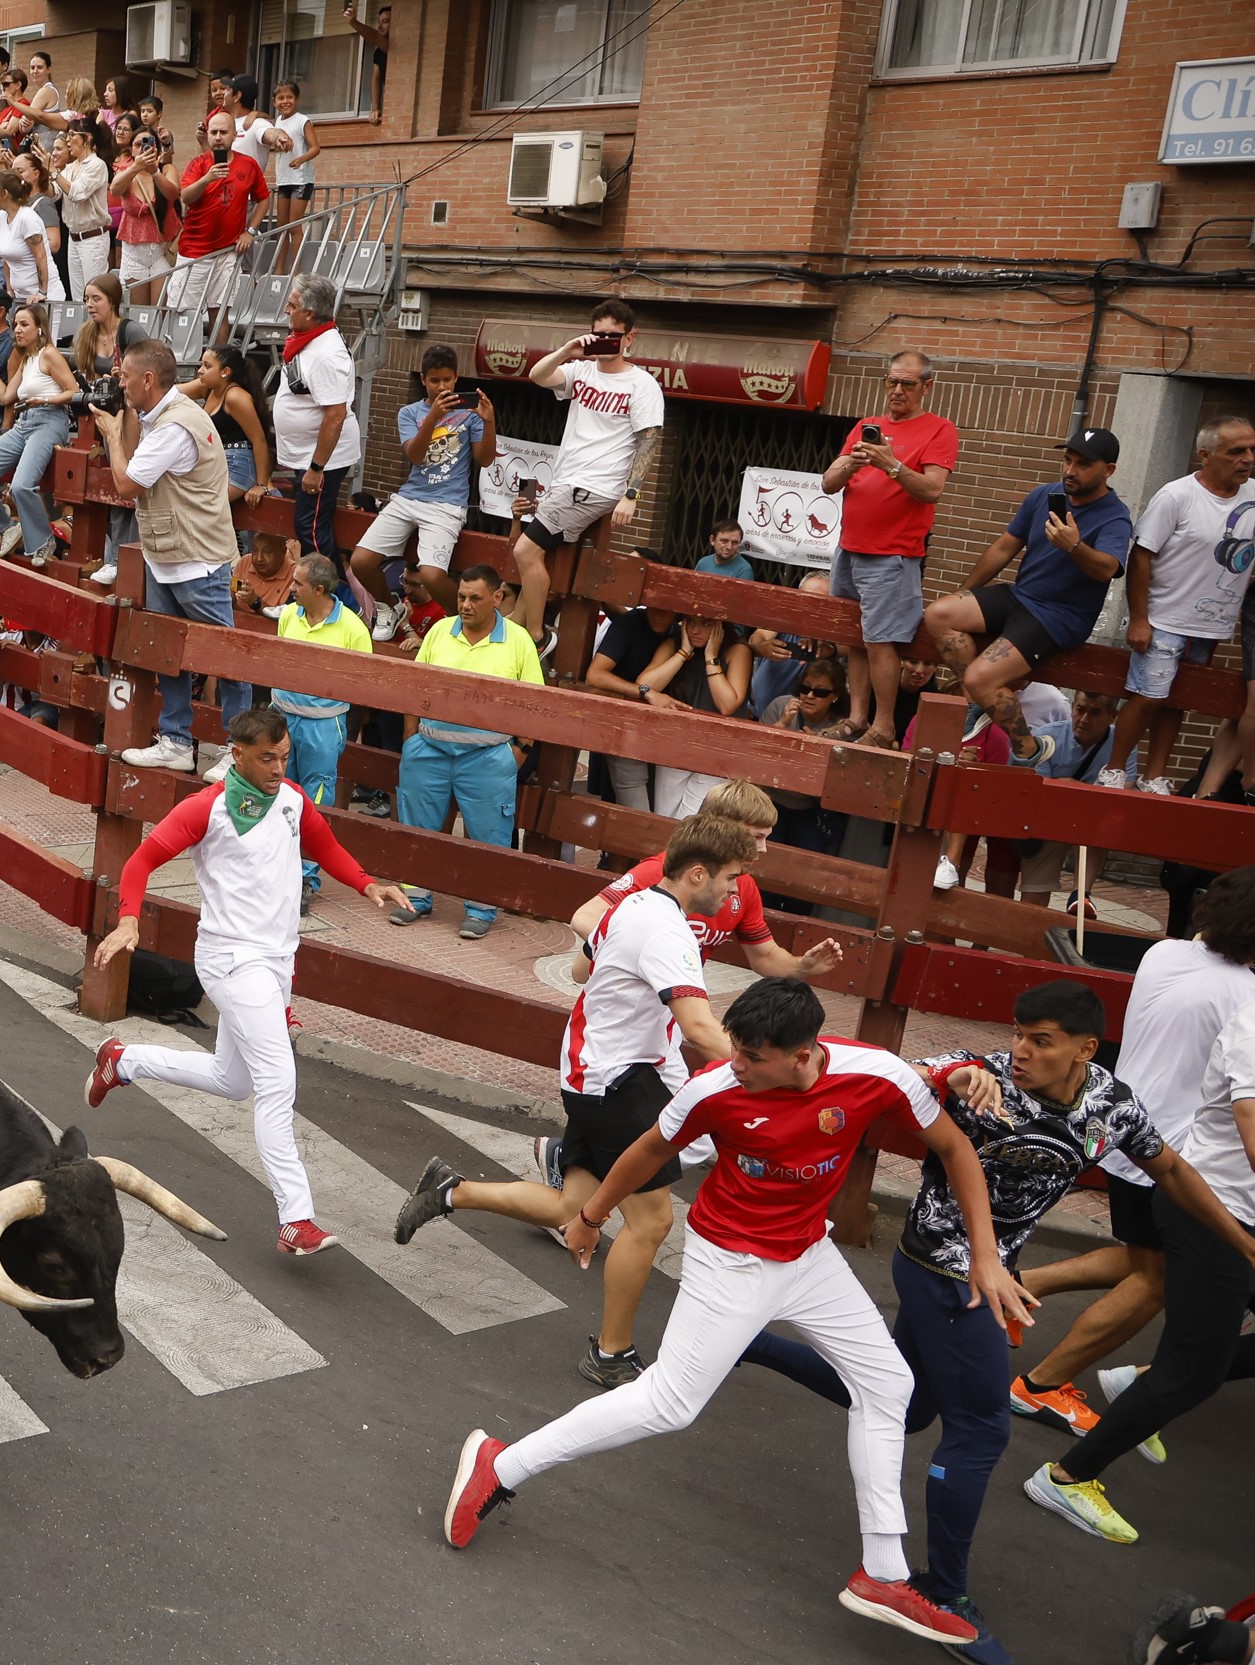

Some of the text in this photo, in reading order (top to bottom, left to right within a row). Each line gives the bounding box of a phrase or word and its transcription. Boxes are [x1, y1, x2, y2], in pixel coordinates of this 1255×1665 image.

[1182, 75, 1255, 122] Clí
[1173, 137, 1255, 156] Tel. 91 6
[486, 339, 527, 354] Mahou
[744, 360, 795, 377] Mahou
[755, 474, 820, 491] San Sebastián de los
[762, 529, 770, 538] de
